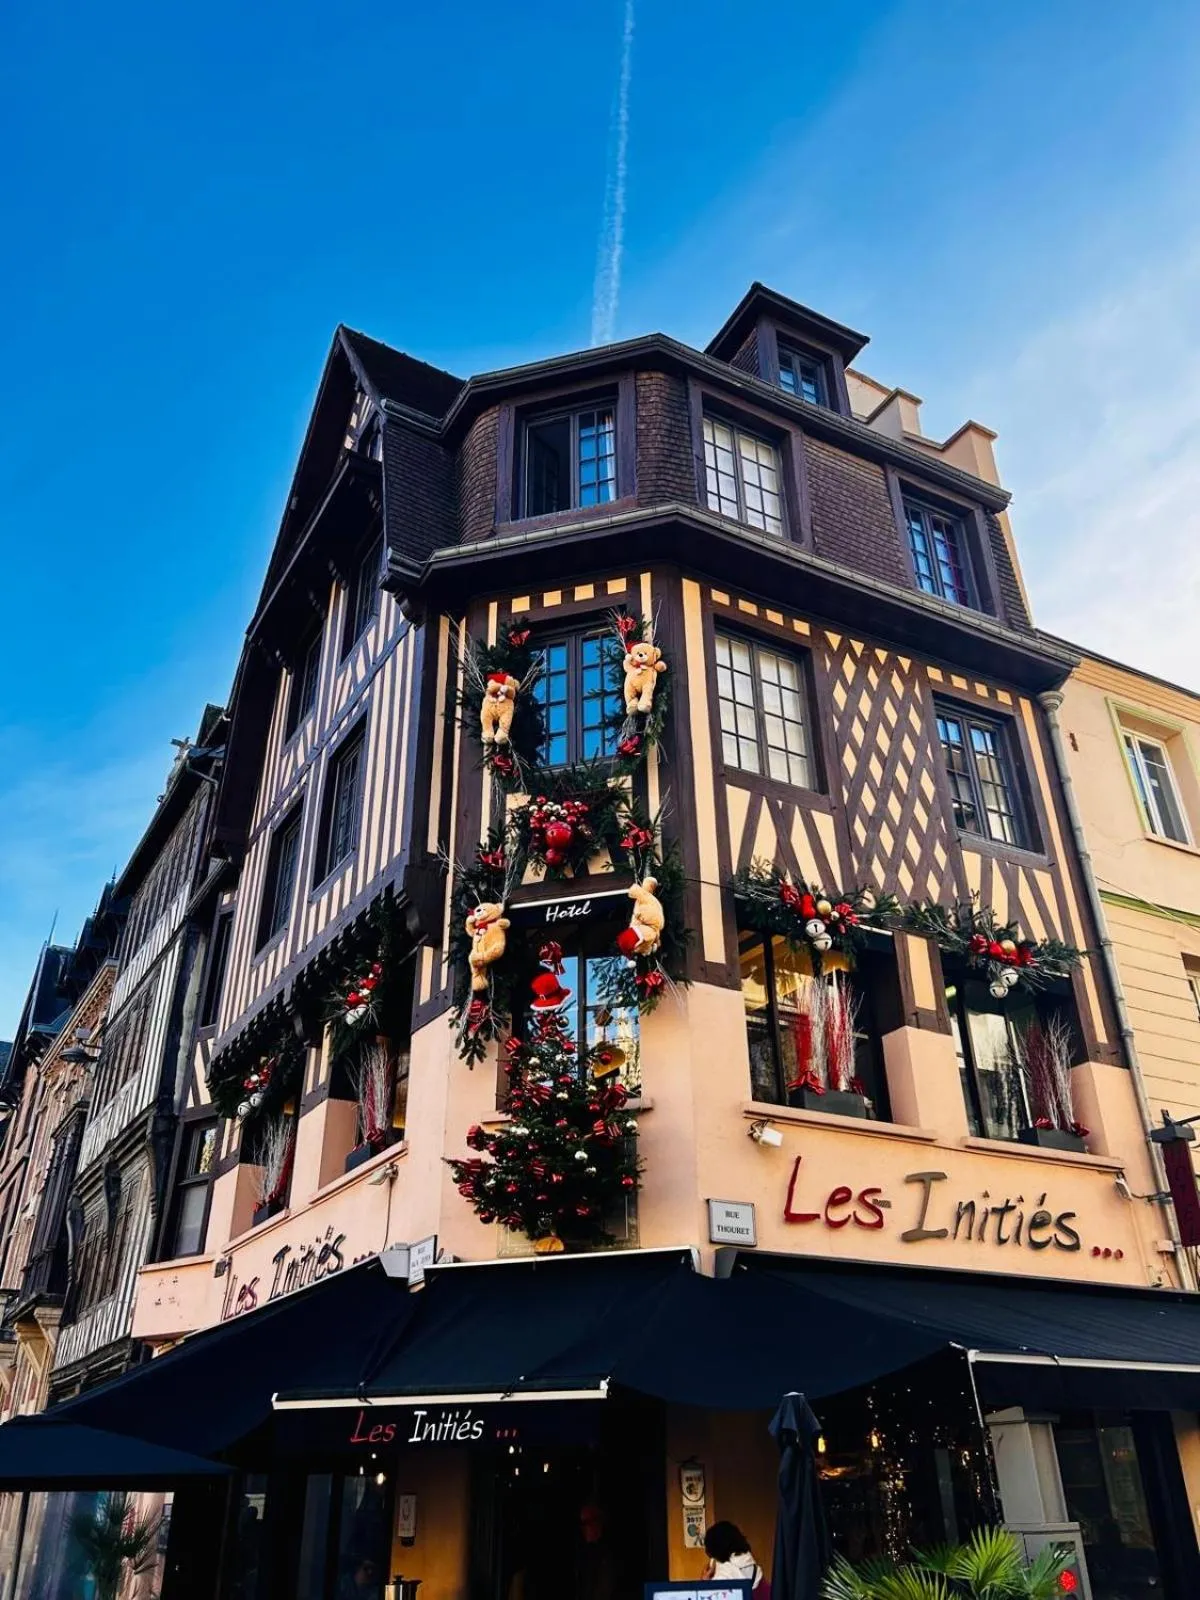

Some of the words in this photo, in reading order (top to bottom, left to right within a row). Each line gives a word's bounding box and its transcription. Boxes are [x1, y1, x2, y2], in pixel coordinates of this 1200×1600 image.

[545, 900, 592, 922] Hotel
[725, 1210, 740, 1219] RUE
[783, 1155, 885, 1230] Les
[901, 1171, 1082, 1252] Initiés
[716, 1224, 751, 1235] THOURET
[220, 1255, 261, 1322] Les
[350, 1409, 397, 1443] Les
[408, 1409, 485, 1443] Initiés
